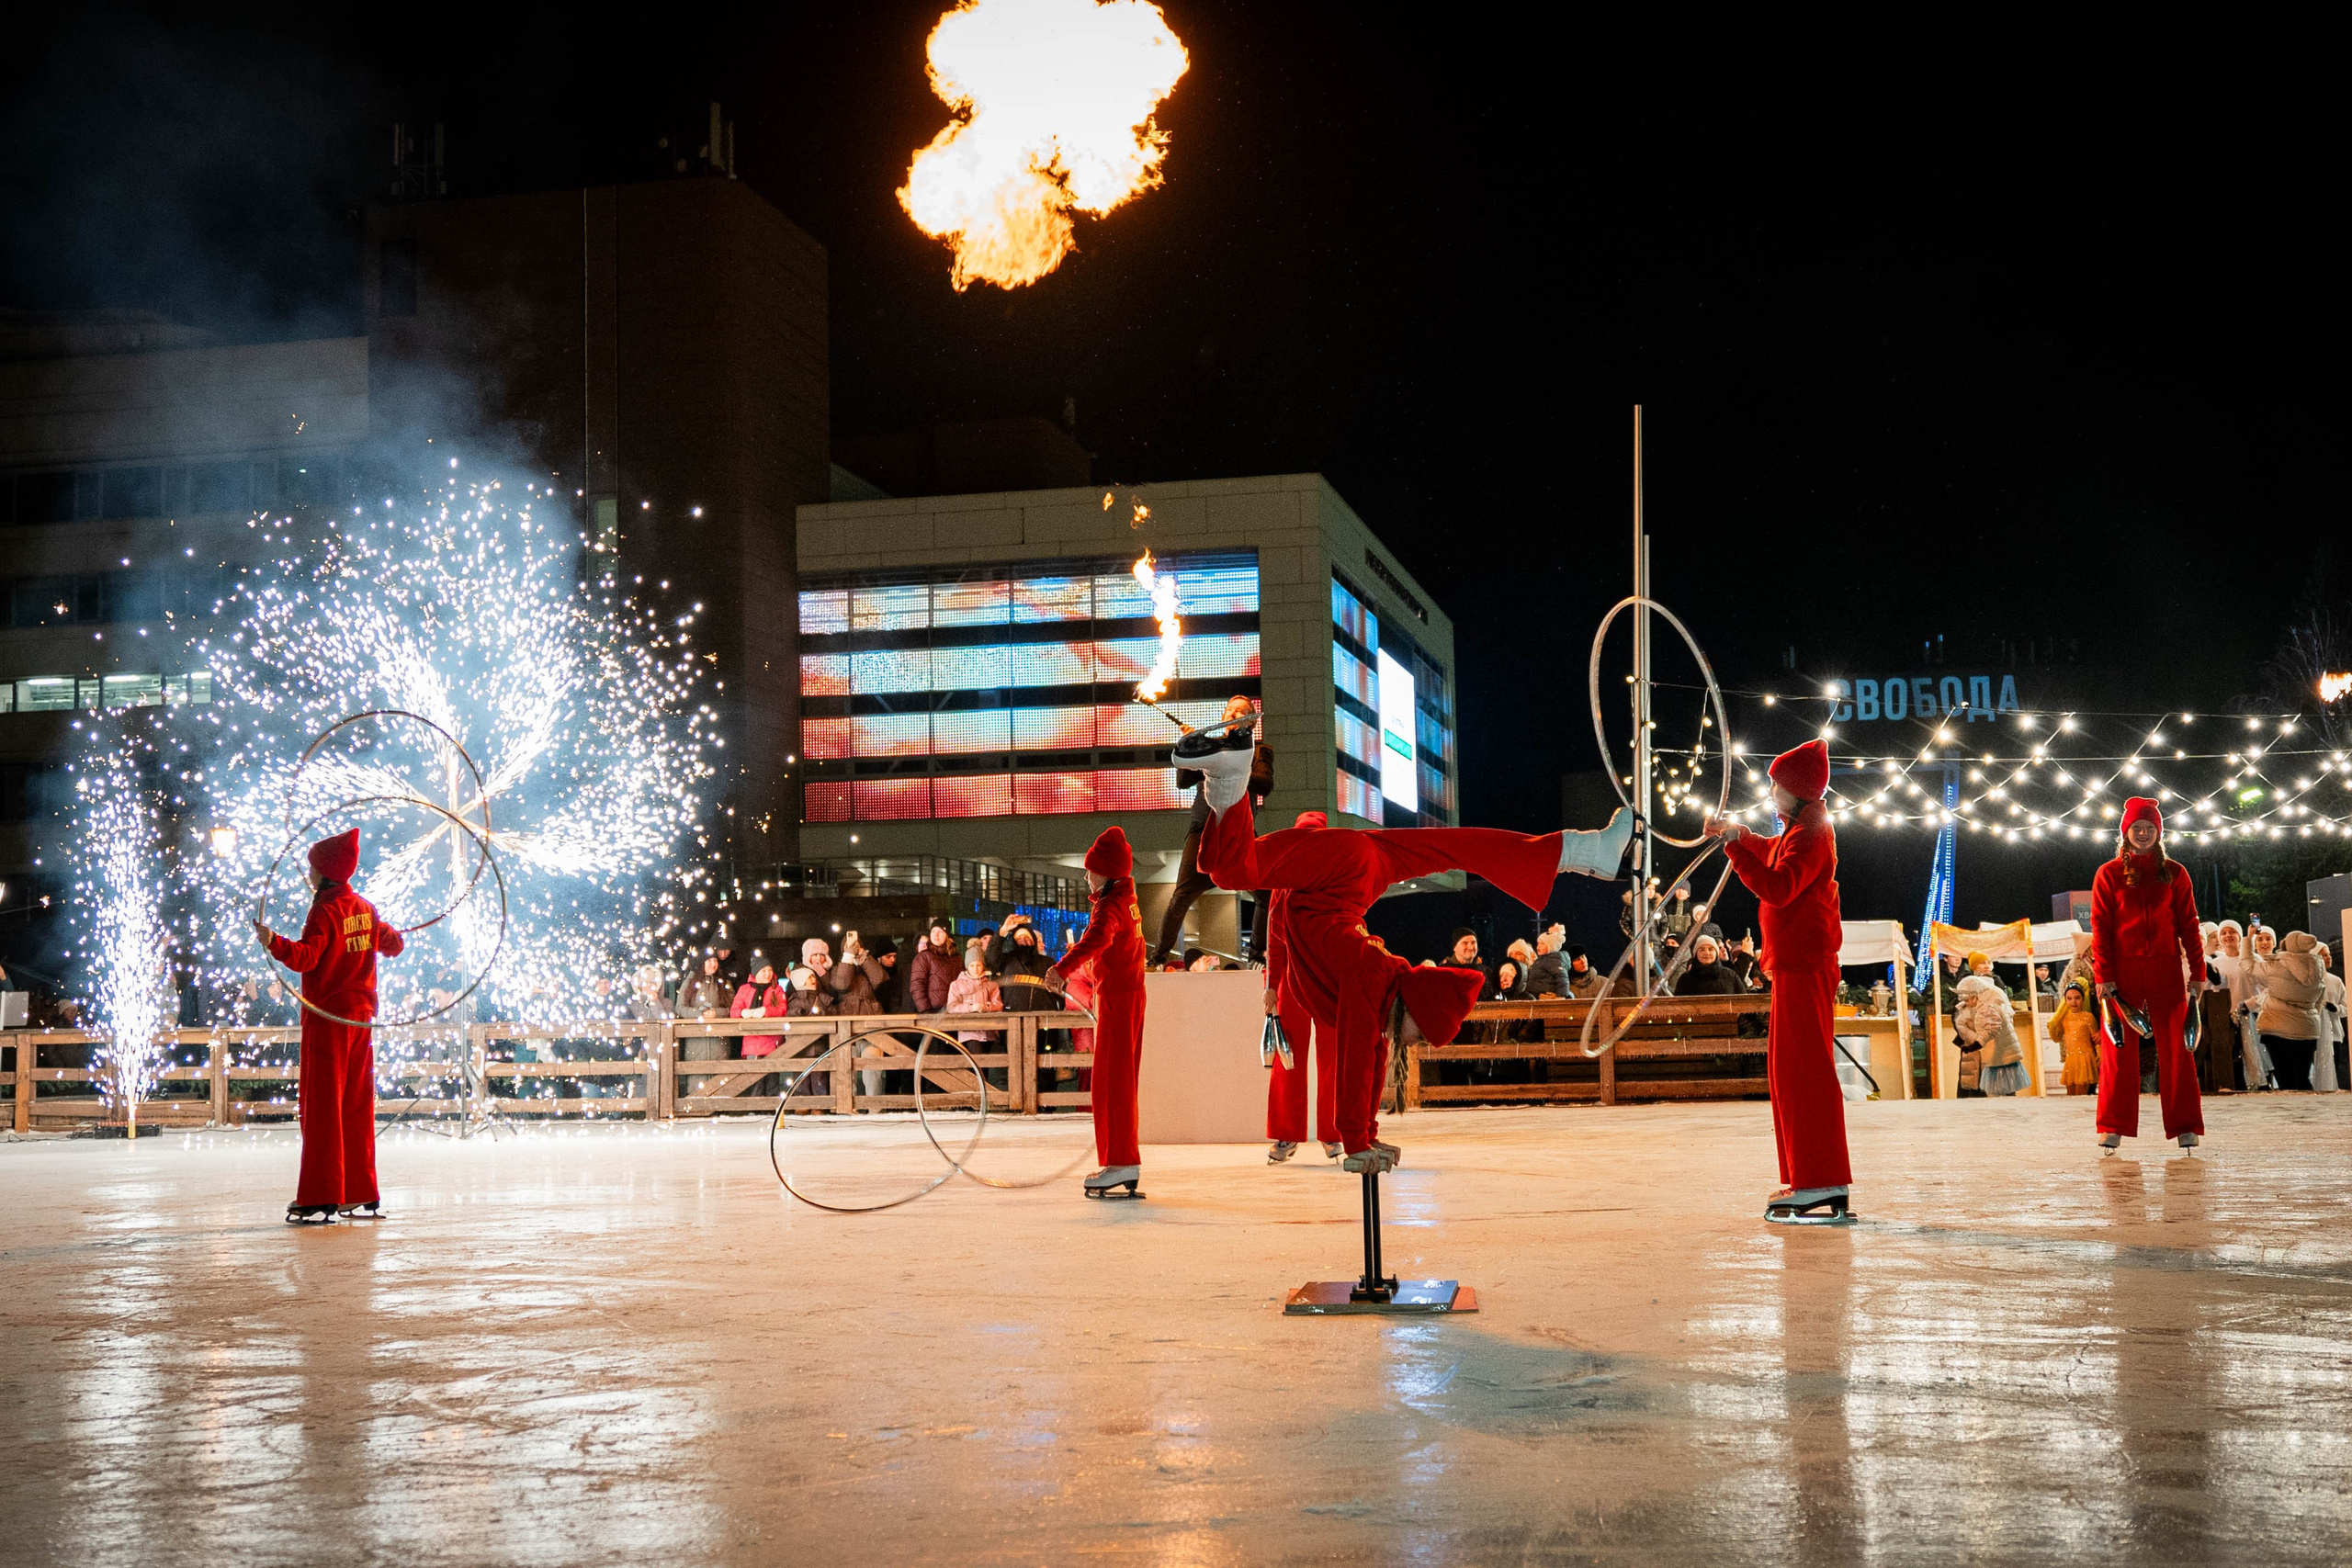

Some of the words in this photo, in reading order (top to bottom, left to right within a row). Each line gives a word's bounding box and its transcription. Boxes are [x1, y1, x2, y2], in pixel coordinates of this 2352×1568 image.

[1828, 674, 2019, 723] СВОБОДА
[344, 913, 372, 935] CIRCUS
[345, 934, 372, 953] TIME
